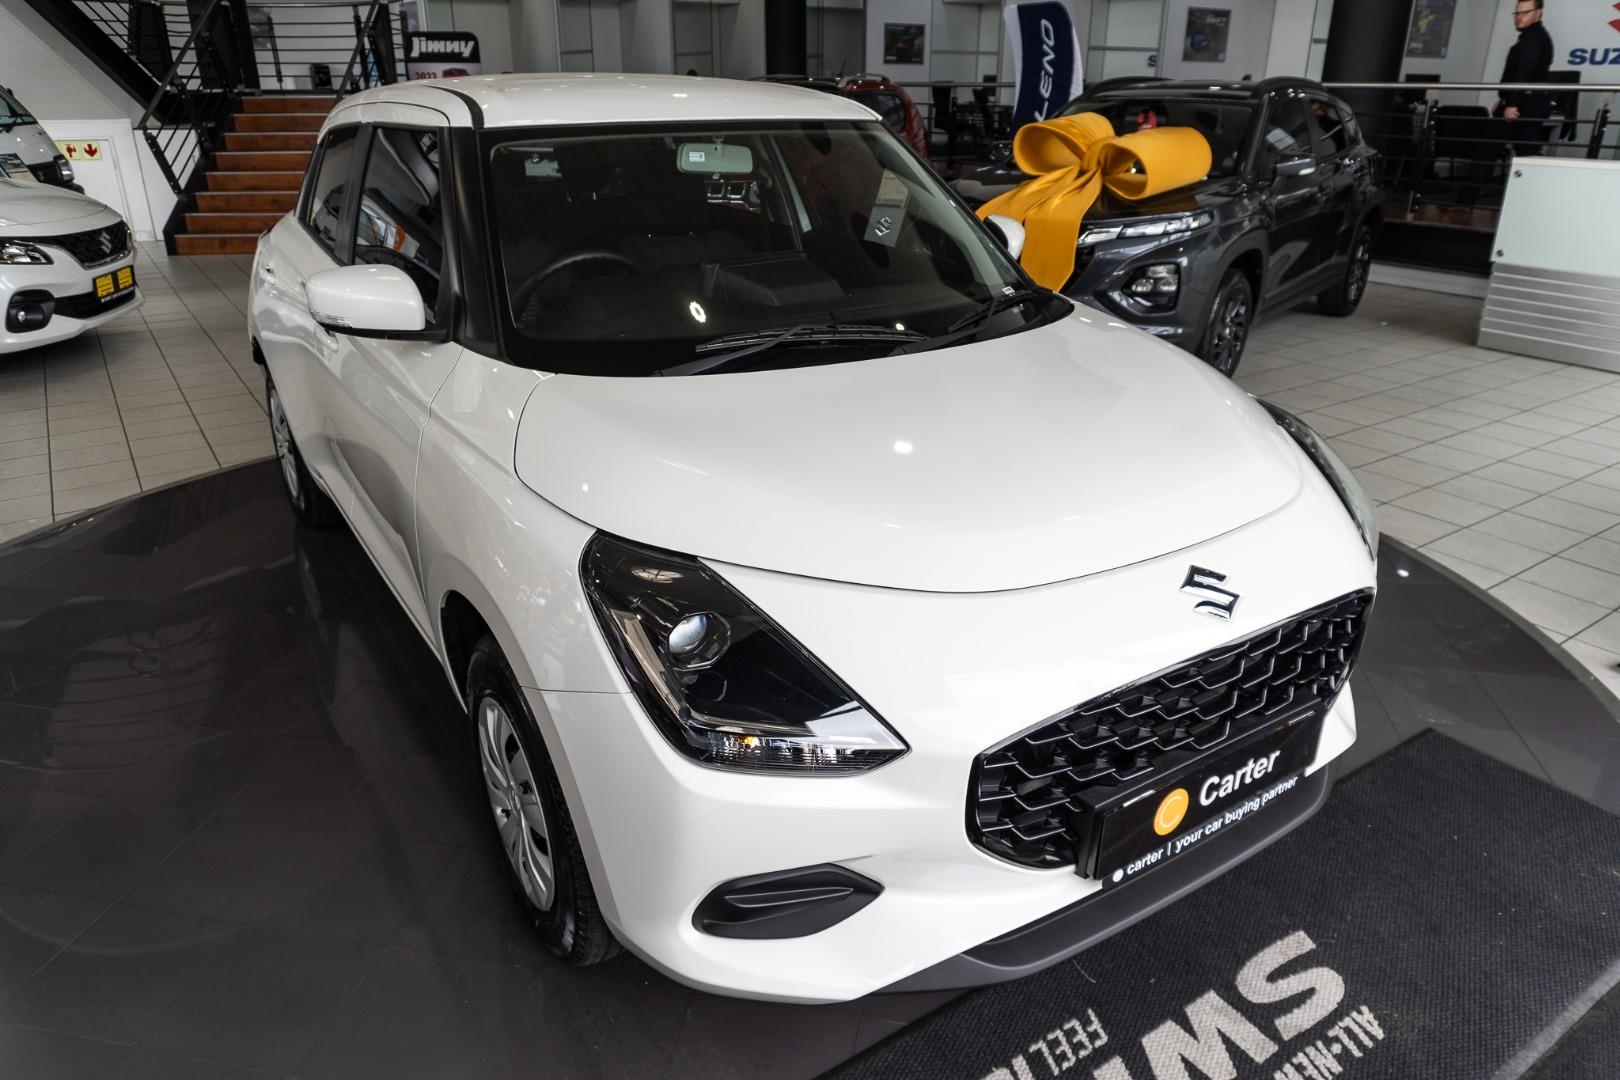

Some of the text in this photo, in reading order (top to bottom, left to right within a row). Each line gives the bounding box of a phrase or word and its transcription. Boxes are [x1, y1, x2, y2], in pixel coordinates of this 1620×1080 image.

[410, 36, 475, 57] Jimny
[1199, 750, 1281, 806] Carter
[1126, 849, 1164, 875] carter
[1175, 828, 1203, 854] your
[1205, 818, 1223, 835] car
[1224, 797, 1261, 825] buying
[1261, 776, 1299, 806] partner
[1028, 1007, 1109, 1077] FEEL
